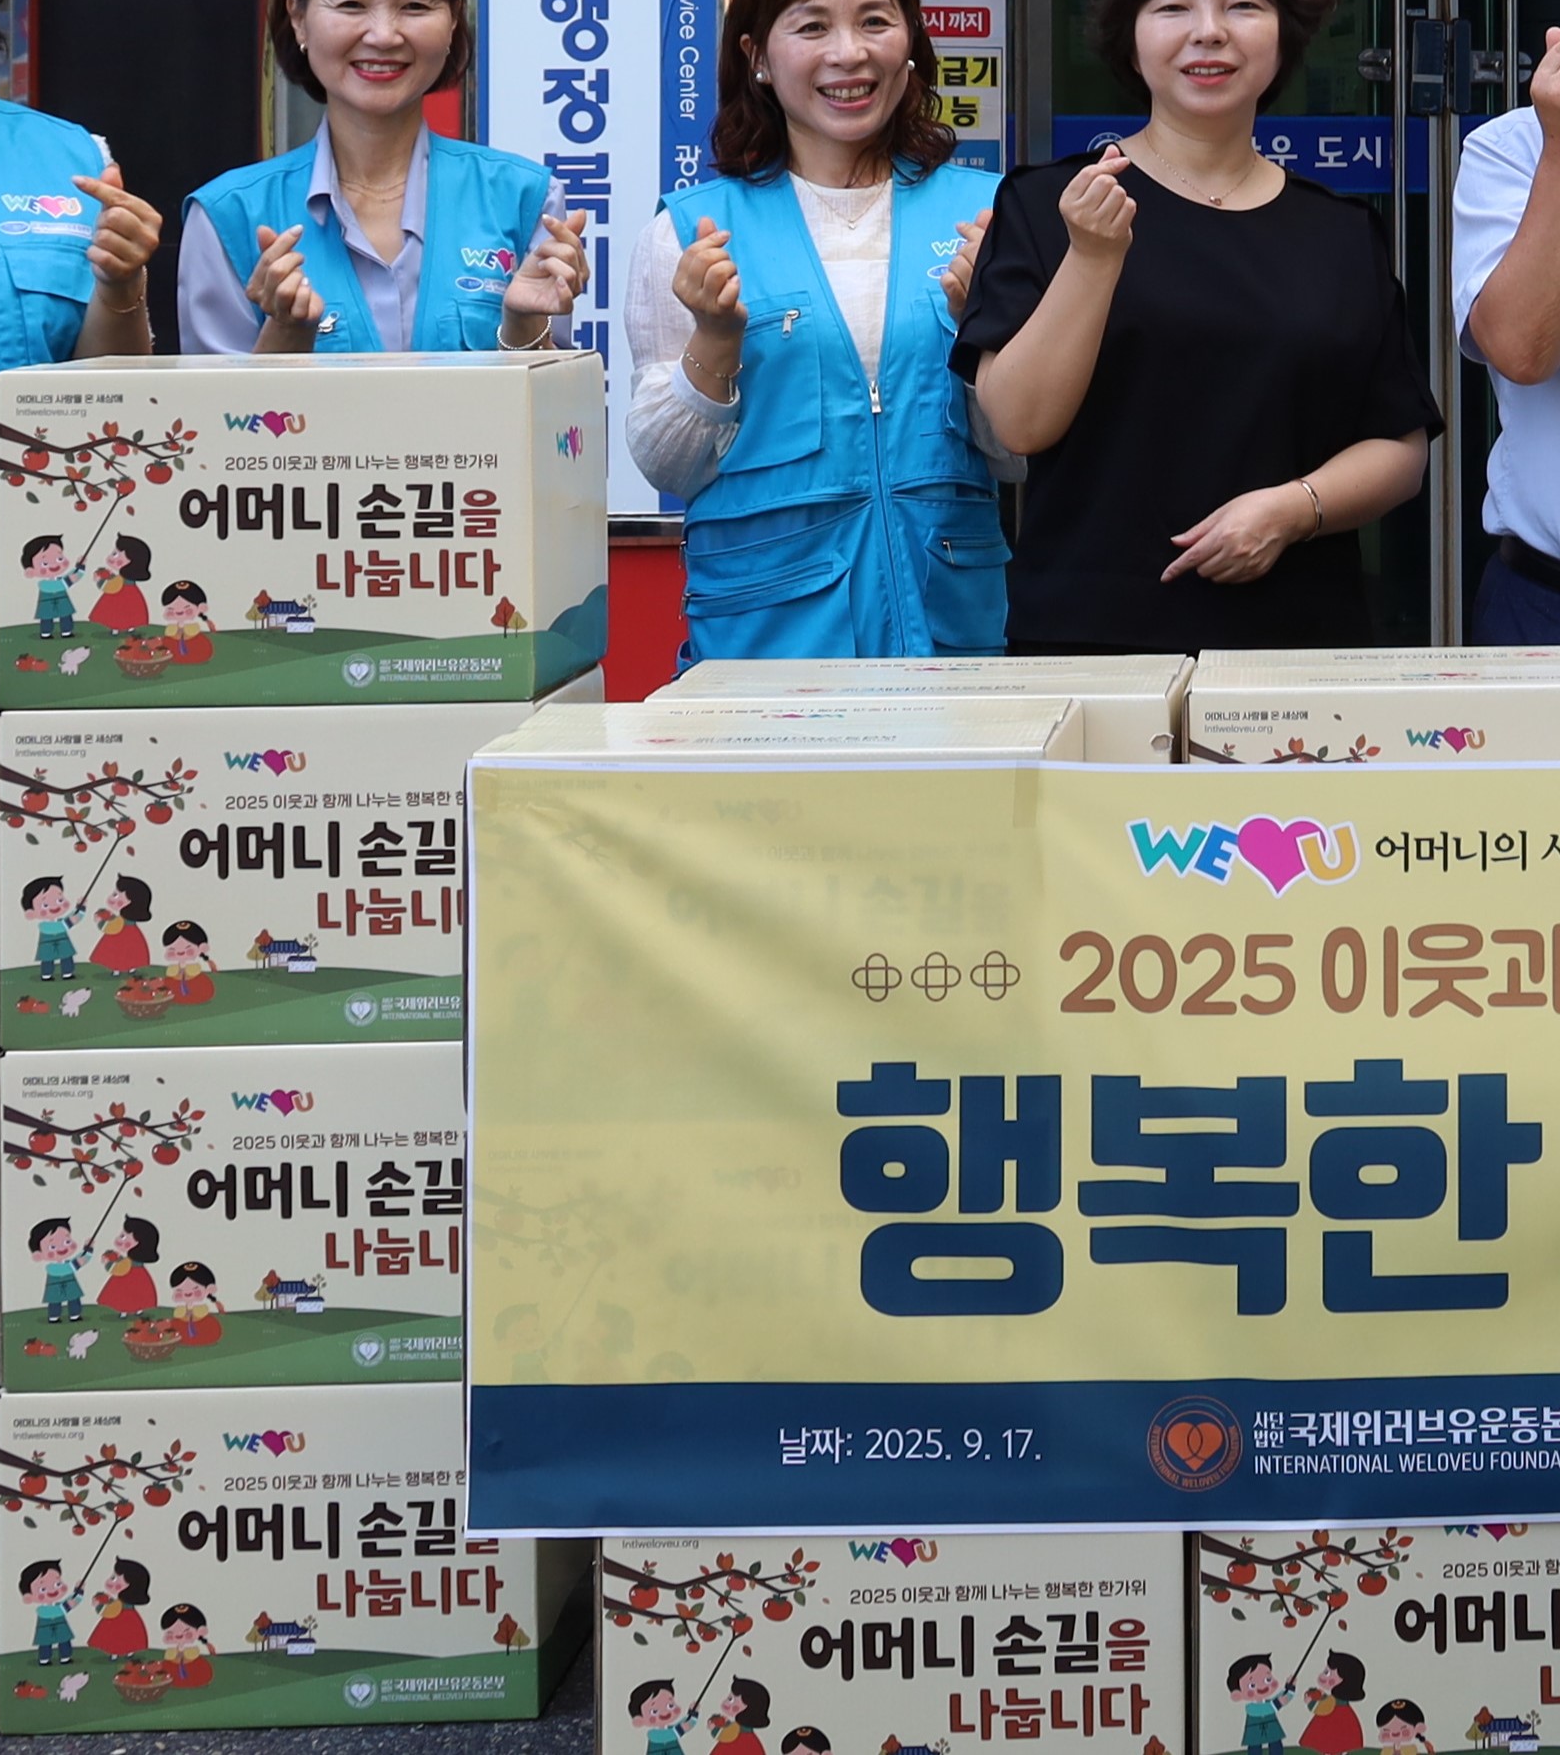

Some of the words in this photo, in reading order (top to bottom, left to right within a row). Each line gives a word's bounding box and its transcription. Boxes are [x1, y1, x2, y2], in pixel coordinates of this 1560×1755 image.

[948, 11, 983, 33] 까지
[678, 44, 699, 121] Center
[937, 56, 998, 87] 급기
[1314, 136, 1383, 170] 도시
[224, 456, 268, 471] 2025
[272, 455, 319, 471] 이웃과
[322, 455, 352, 471] 함께
[355, 454, 401, 470] 나누는
[404, 454, 451, 471] 행복한
[454, 453, 499, 470] 한가위
[179, 482, 340, 541] 어머니
[356, 480, 502, 540] 손길을
[316, 549, 502, 599] 나눕니다
[1373, 830, 1530, 876] 어머니의
[1057, 927, 1297, 1017] 2025
[835, 1057, 1543, 1318] 행복한
[1253, 1410, 1285, 1429] 사단
[1253, 1429, 1285, 1449] 법인
[777, 1425, 853, 1467] 날짜:
[864, 1425, 954, 1462] 2025.
[962, 1425, 989, 1461] 9.
[998, 1425, 1043, 1461] 17.
[1254, 1452, 1394, 1475] INTERNATIONAL
[1398, 1451, 1485, 1473] WELOVEU
[178, 1503, 340, 1562] 어머니
[315, 1565, 504, 1618] 나눕니다
[799, 1614, 976, 1682] 어머니
[991, 1612, 1152, 1677] 손길을
[948, 1682, 1152, 1743] 나눕니다
